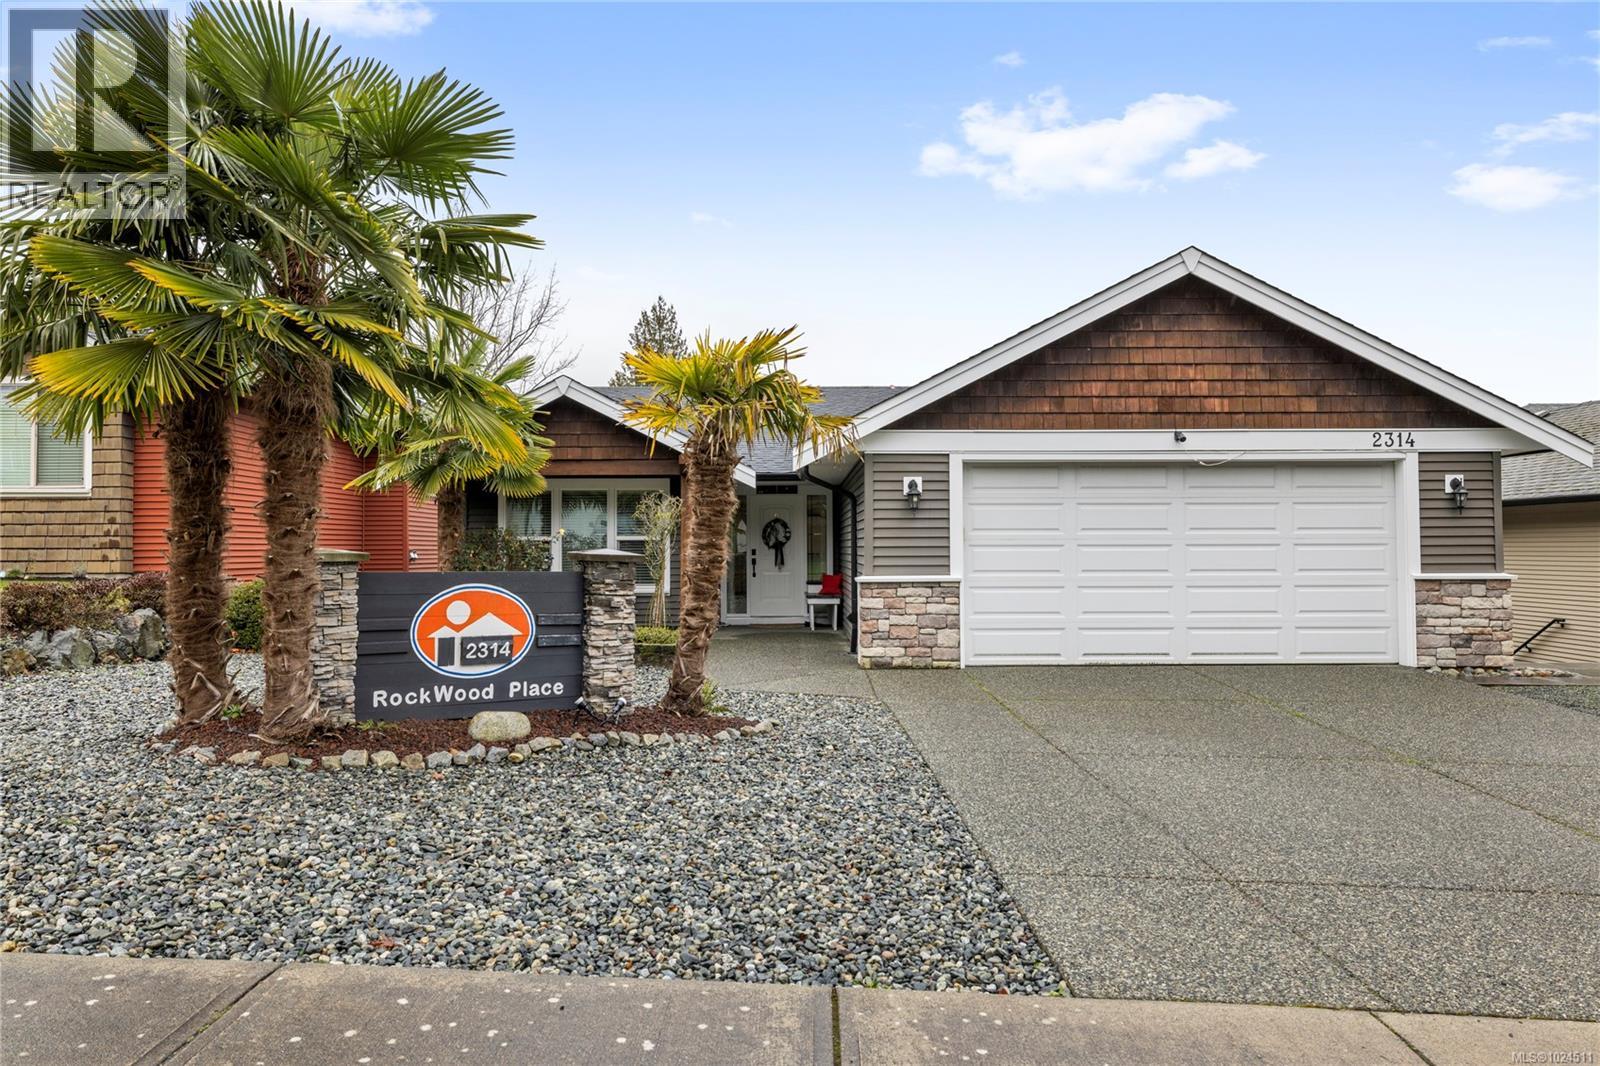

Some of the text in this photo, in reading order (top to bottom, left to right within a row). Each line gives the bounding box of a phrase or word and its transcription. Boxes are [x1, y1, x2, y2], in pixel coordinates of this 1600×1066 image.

[1372, 432, 1416, 448] 2314
[465, 641, 512, 660] 2314
[372, 680, 565, 708] RockWood Place
